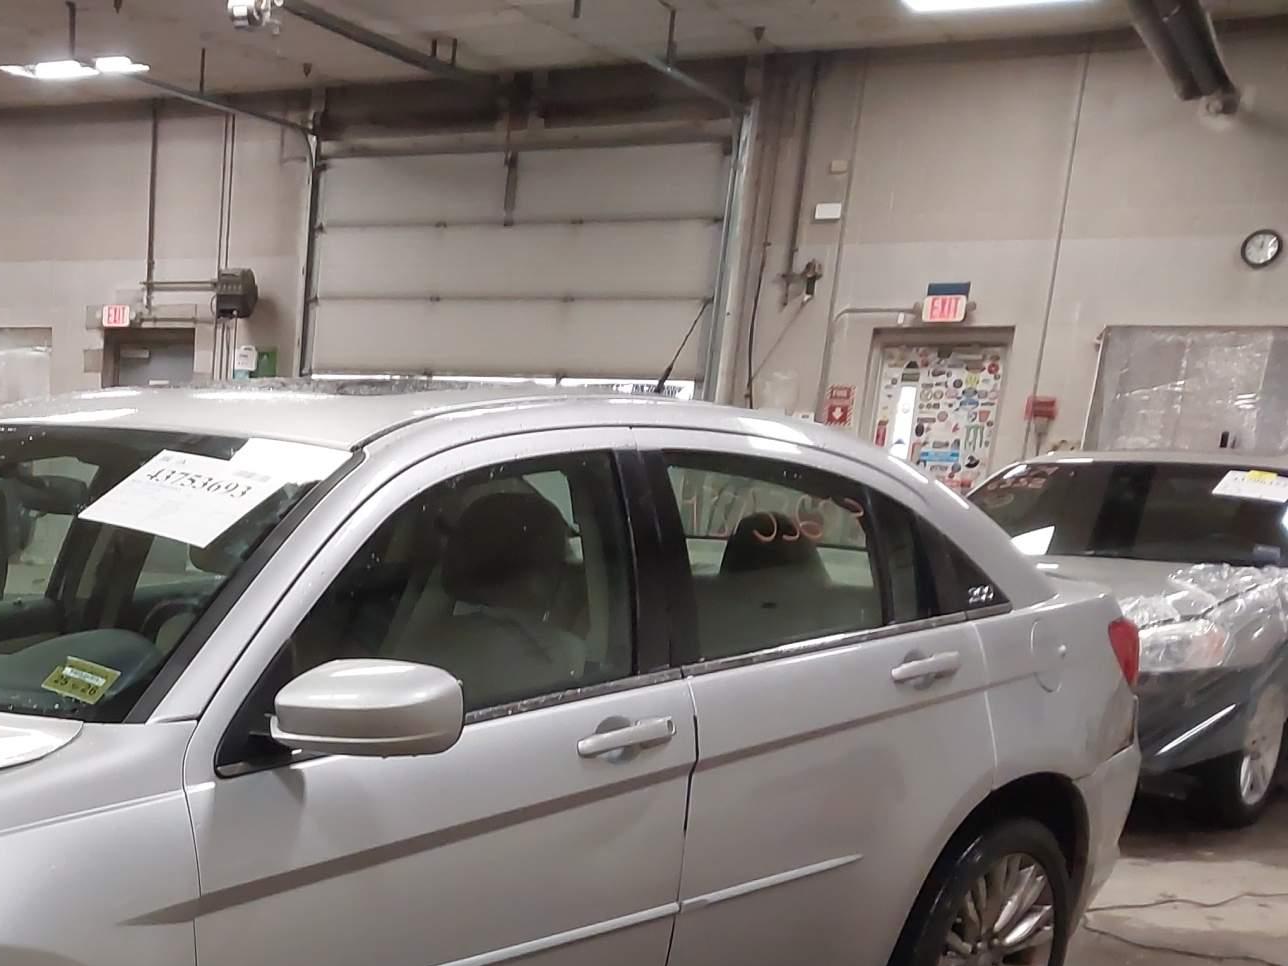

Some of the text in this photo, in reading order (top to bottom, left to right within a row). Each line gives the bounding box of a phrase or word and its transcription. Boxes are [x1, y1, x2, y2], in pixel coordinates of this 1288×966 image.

[107, 306, 127, 325] EXIT
[929, 297, 961, 319] EXIT
[145, 467, 253, 499] 43753693
